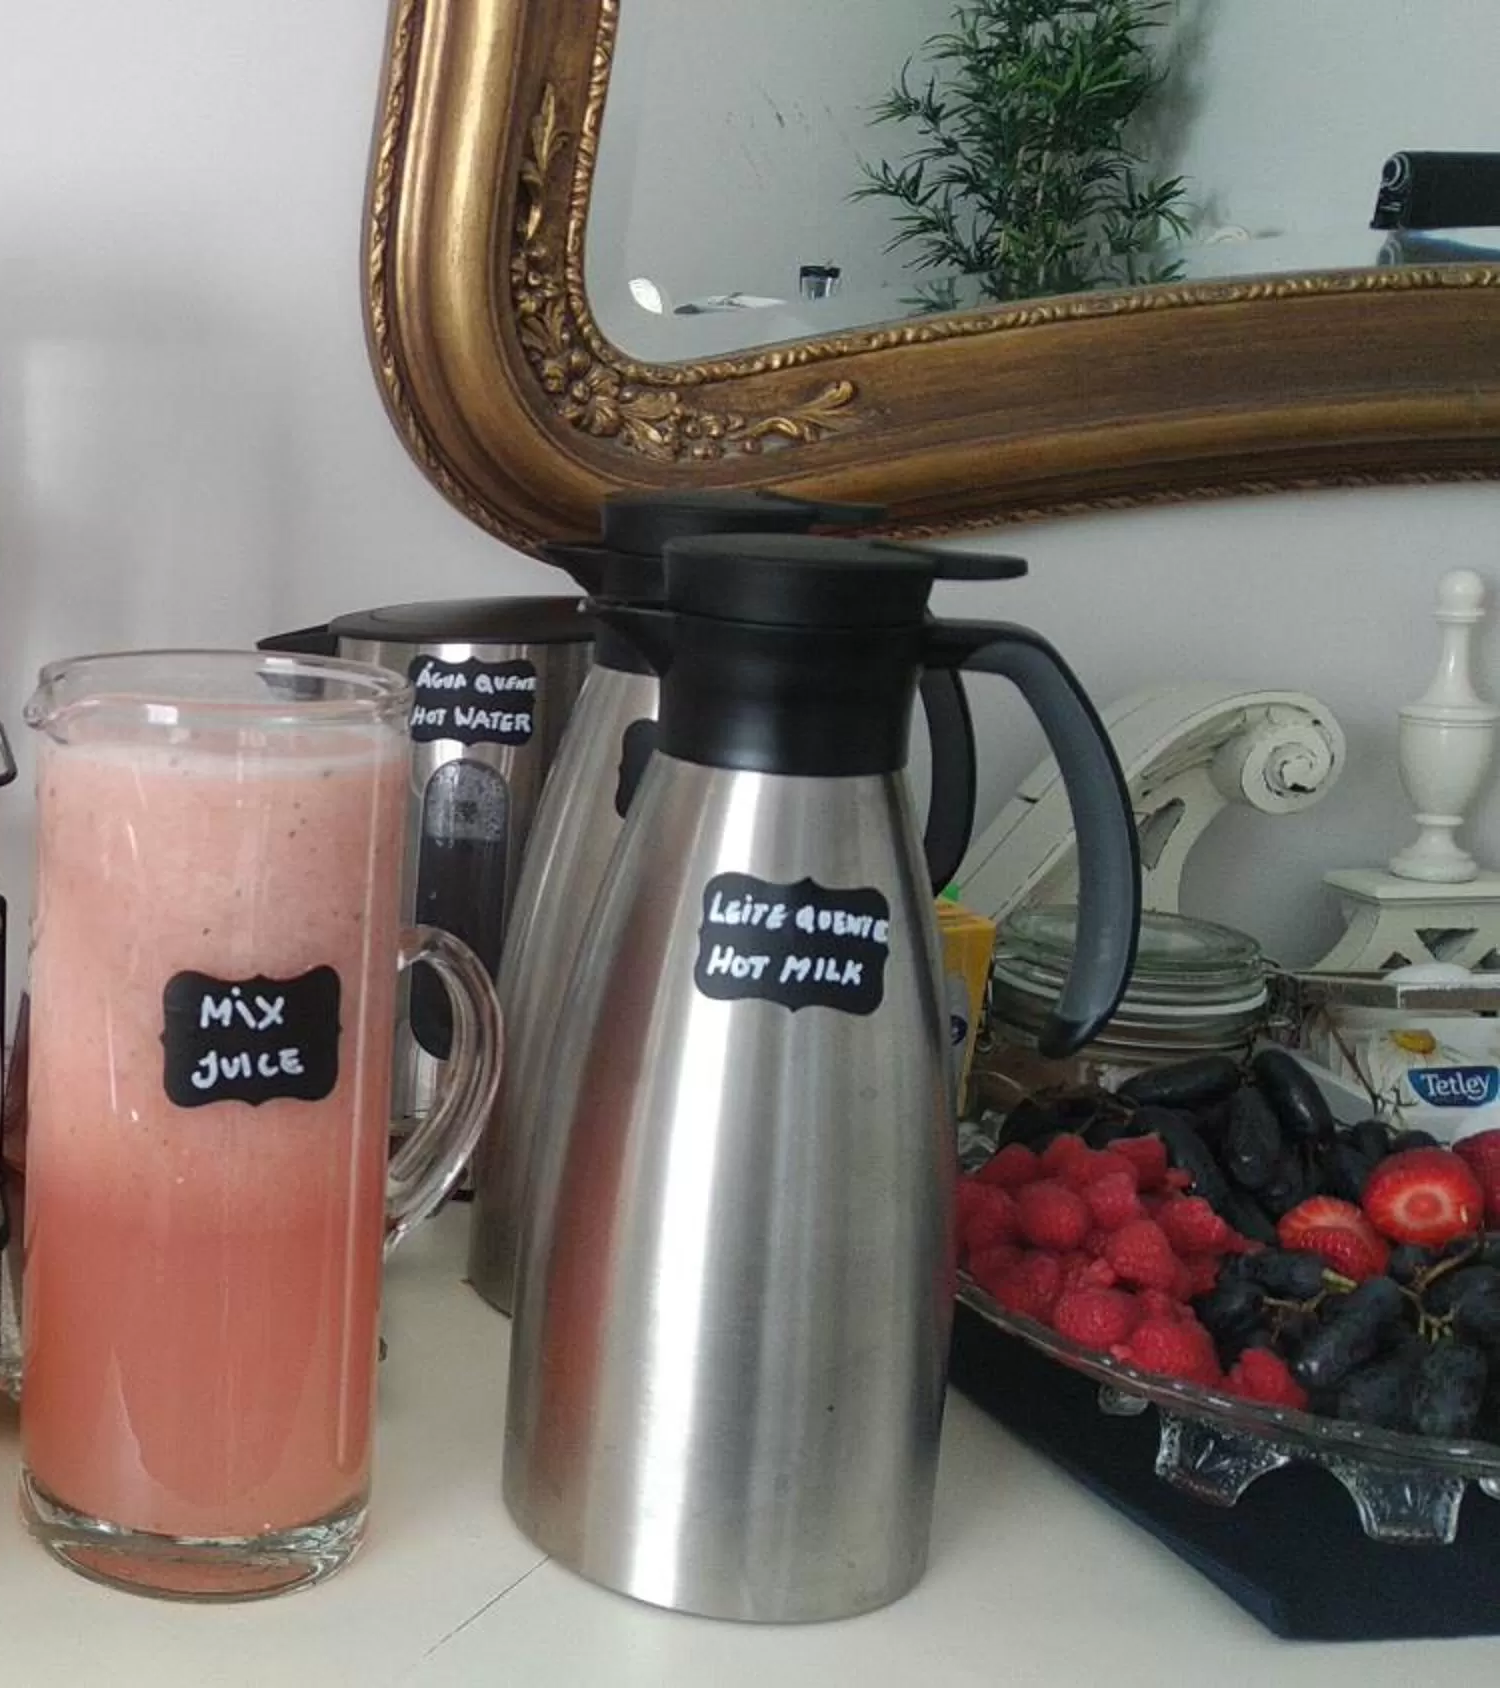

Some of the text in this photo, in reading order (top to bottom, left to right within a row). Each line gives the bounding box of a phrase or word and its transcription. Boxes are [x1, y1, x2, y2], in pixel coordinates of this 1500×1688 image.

[415, 661, 468, 690] ÁGUA
[410, 705, 531, 733] HOT WATER
[795, 904, 889, 944] QUENTE
[706, 944, 864, 986] HOT MILK
[191, 1048, 305, 1089] JUICE
[1419, 1071, 1491, 1100] Tetley
